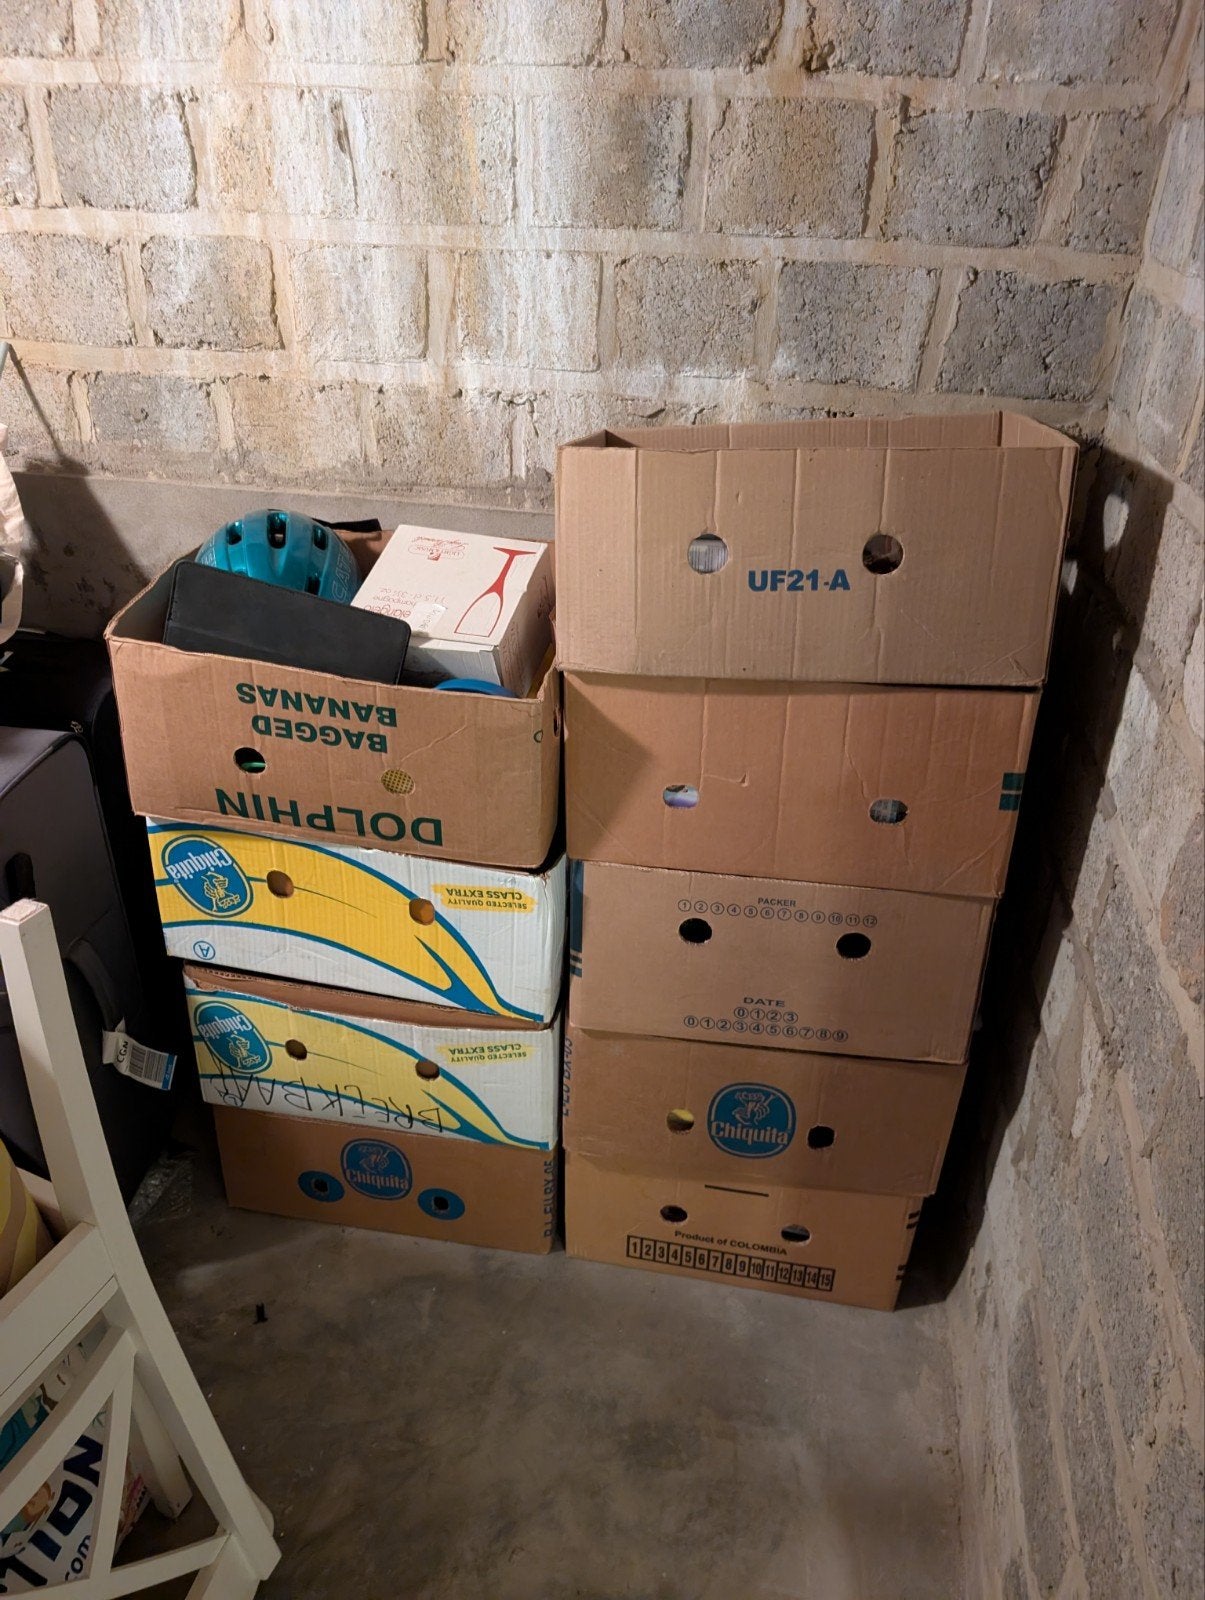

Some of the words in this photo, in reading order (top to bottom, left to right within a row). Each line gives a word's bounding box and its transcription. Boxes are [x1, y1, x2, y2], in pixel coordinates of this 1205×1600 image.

[747, 568, 850, 593] UF21-A
[235, 682, 397, 728] BANANAS
[251, 714, 389, 754] BAGGED
[214, 787, 444, 847] DOLPHIN
[165, 847, 233, 880] Chiquita
[445, 887, 484, 898] EXTRA
[486, 889, 523, 901] CLASS
[447, 898, 484, 907] QUALITY
[485, 900, 528, 910] SELECTED
[757, 897, 797, 907] PACKER
[743, 997, 785, 1008] DATE
[197, 1014, 253, 1040] Chiquita
[117, 1041, 129, 1063] CGN
[447, 1046, 485, 1055] EXTRA
[486, 1043, 522, 1053] CLASS
[487, 1051, 527, 1060] SELECTED
[450, 1054, 486, 1063] QUALITY
[710, 1120, 789, 1146] Chiquita
[345, 1169, 410, 1191] Chiquita
[674, 1230, 714, 1244] Product
[716, 1237, 728, 1246] of
[729, 1239, 788, 1256] COLOMBIA
